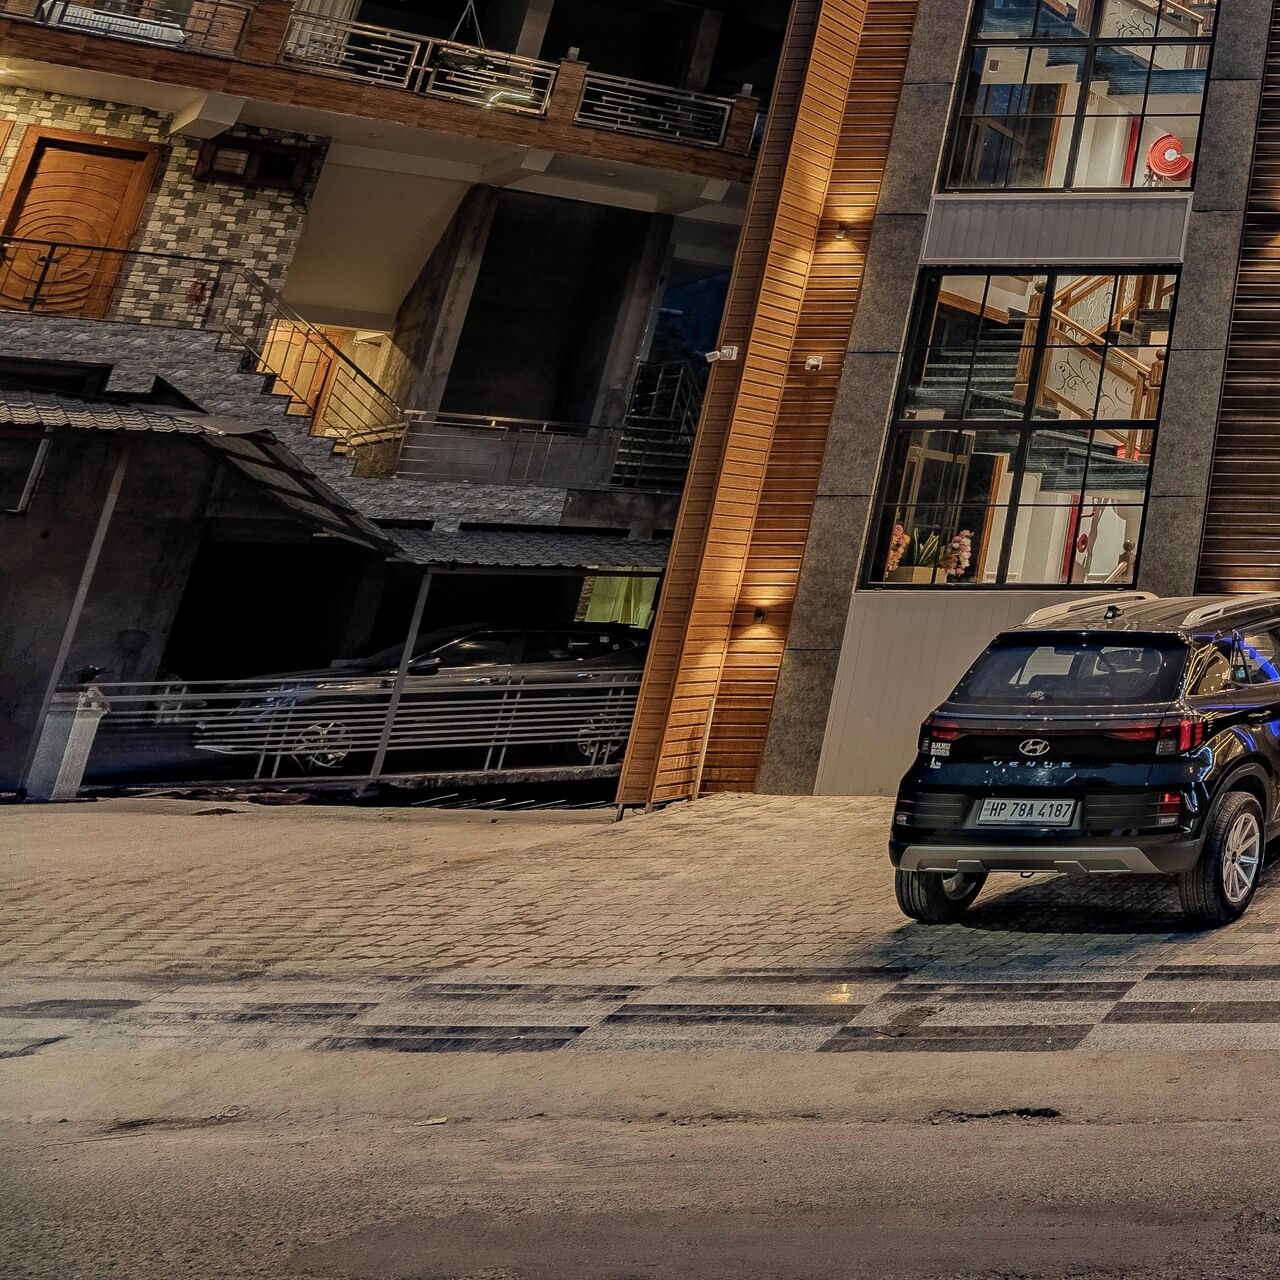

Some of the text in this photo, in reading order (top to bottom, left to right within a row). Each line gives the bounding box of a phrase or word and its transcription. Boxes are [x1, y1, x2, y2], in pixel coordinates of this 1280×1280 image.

[989, 802, 1007, 817] HP
[1009, 802, 1034, 818] 78A
[1037, 802, 1072, 818] 4187
